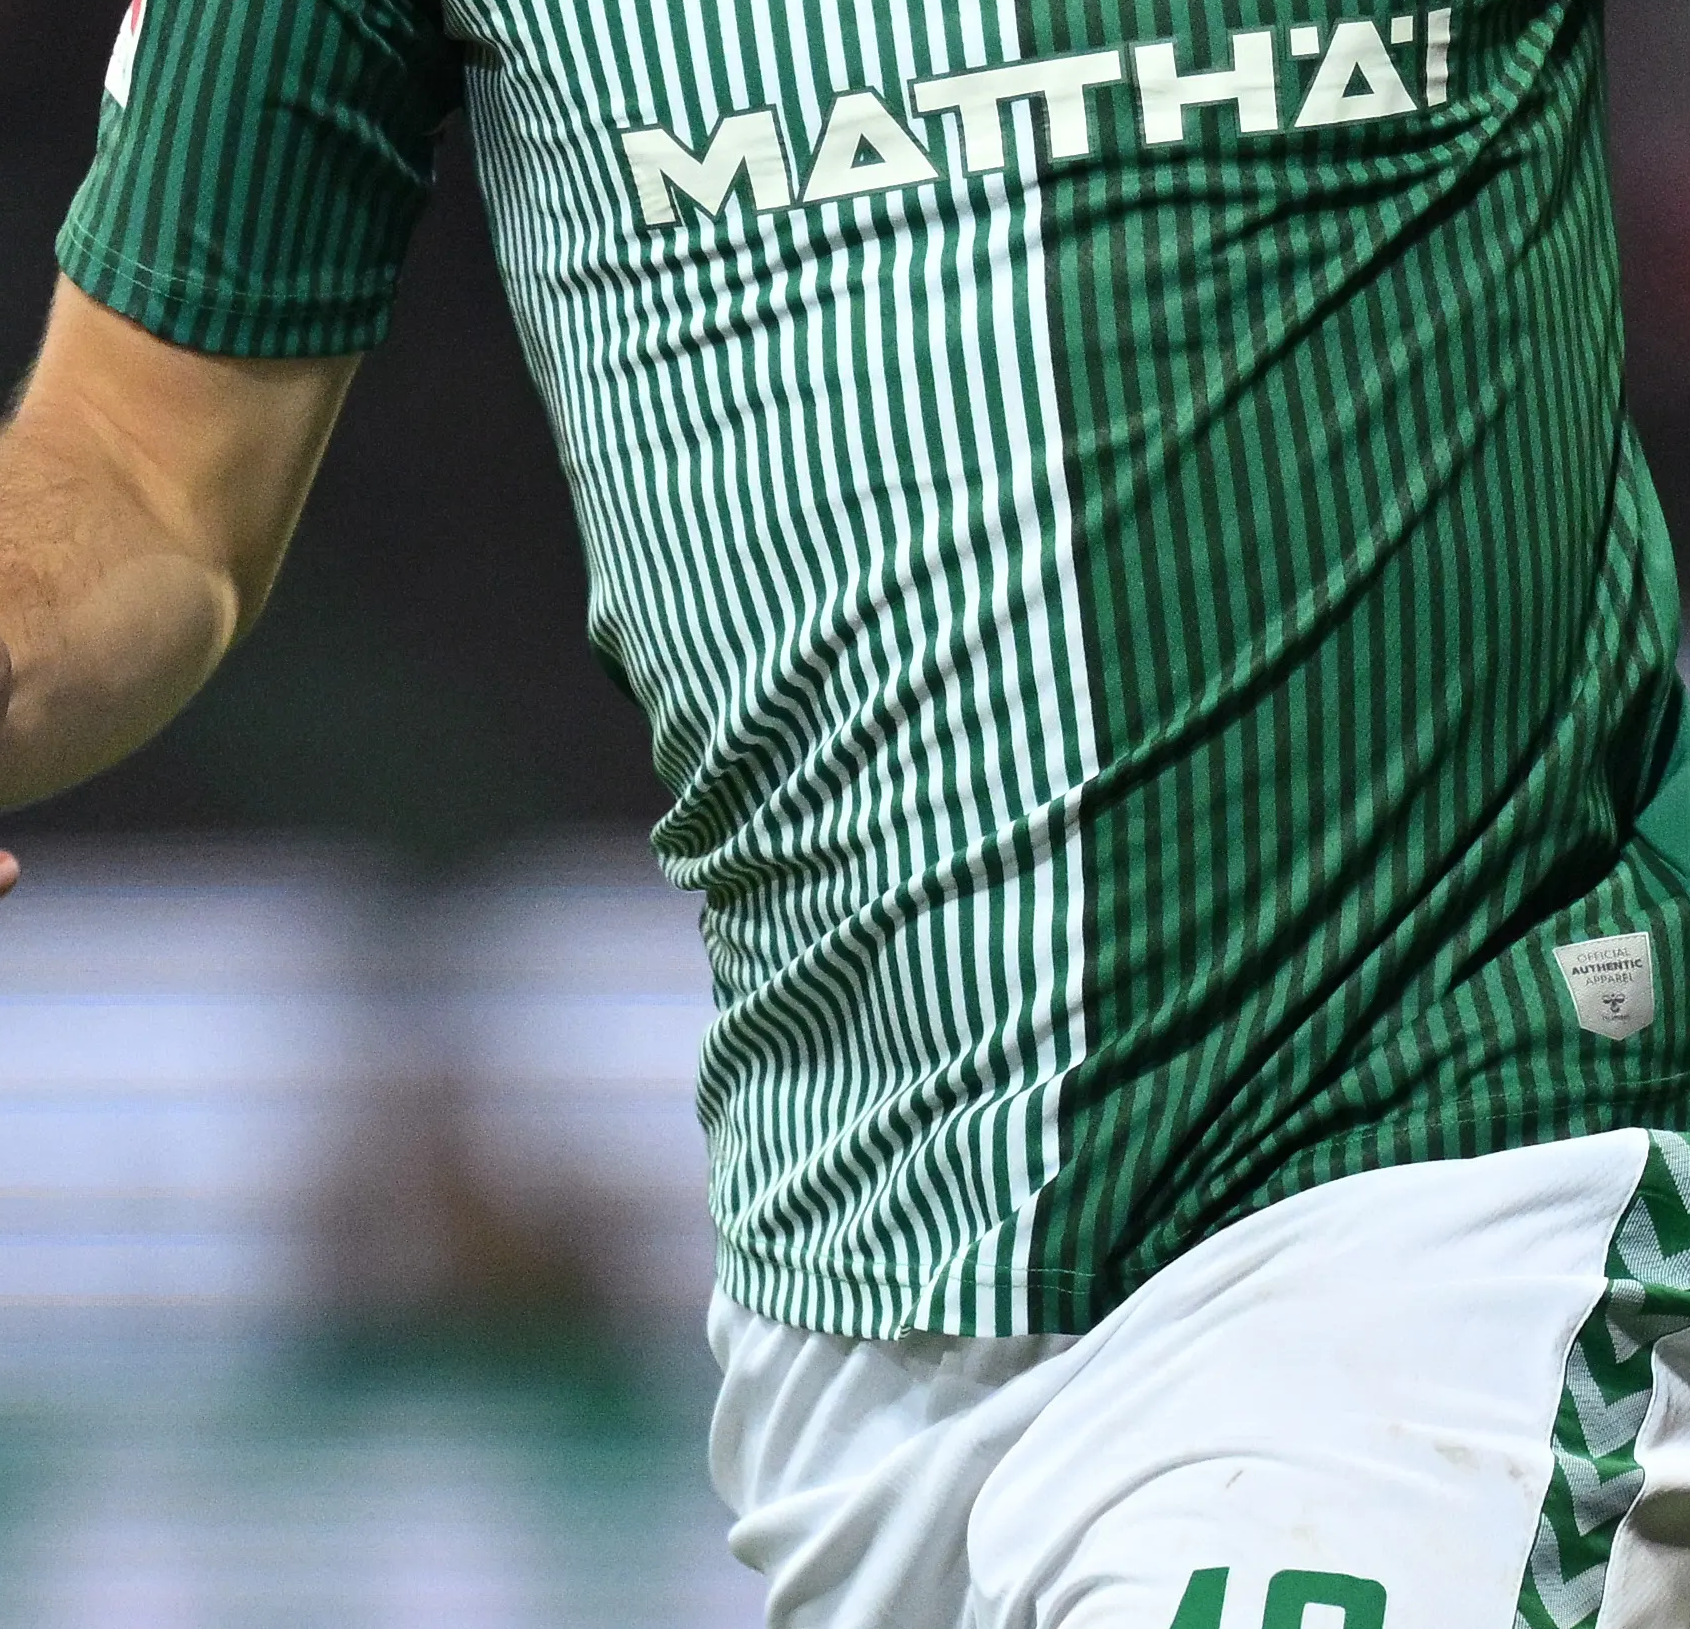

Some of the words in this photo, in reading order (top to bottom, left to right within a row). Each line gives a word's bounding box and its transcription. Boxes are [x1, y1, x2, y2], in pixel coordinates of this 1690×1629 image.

[620, 7, 1453, 228] MATTHÄI
[1577, 947, 1631, 962] OFFICIAL
[1572, 958, 1643, 975] AUTHENTIC
[1586, 973, 1634, 985] APPAREL
